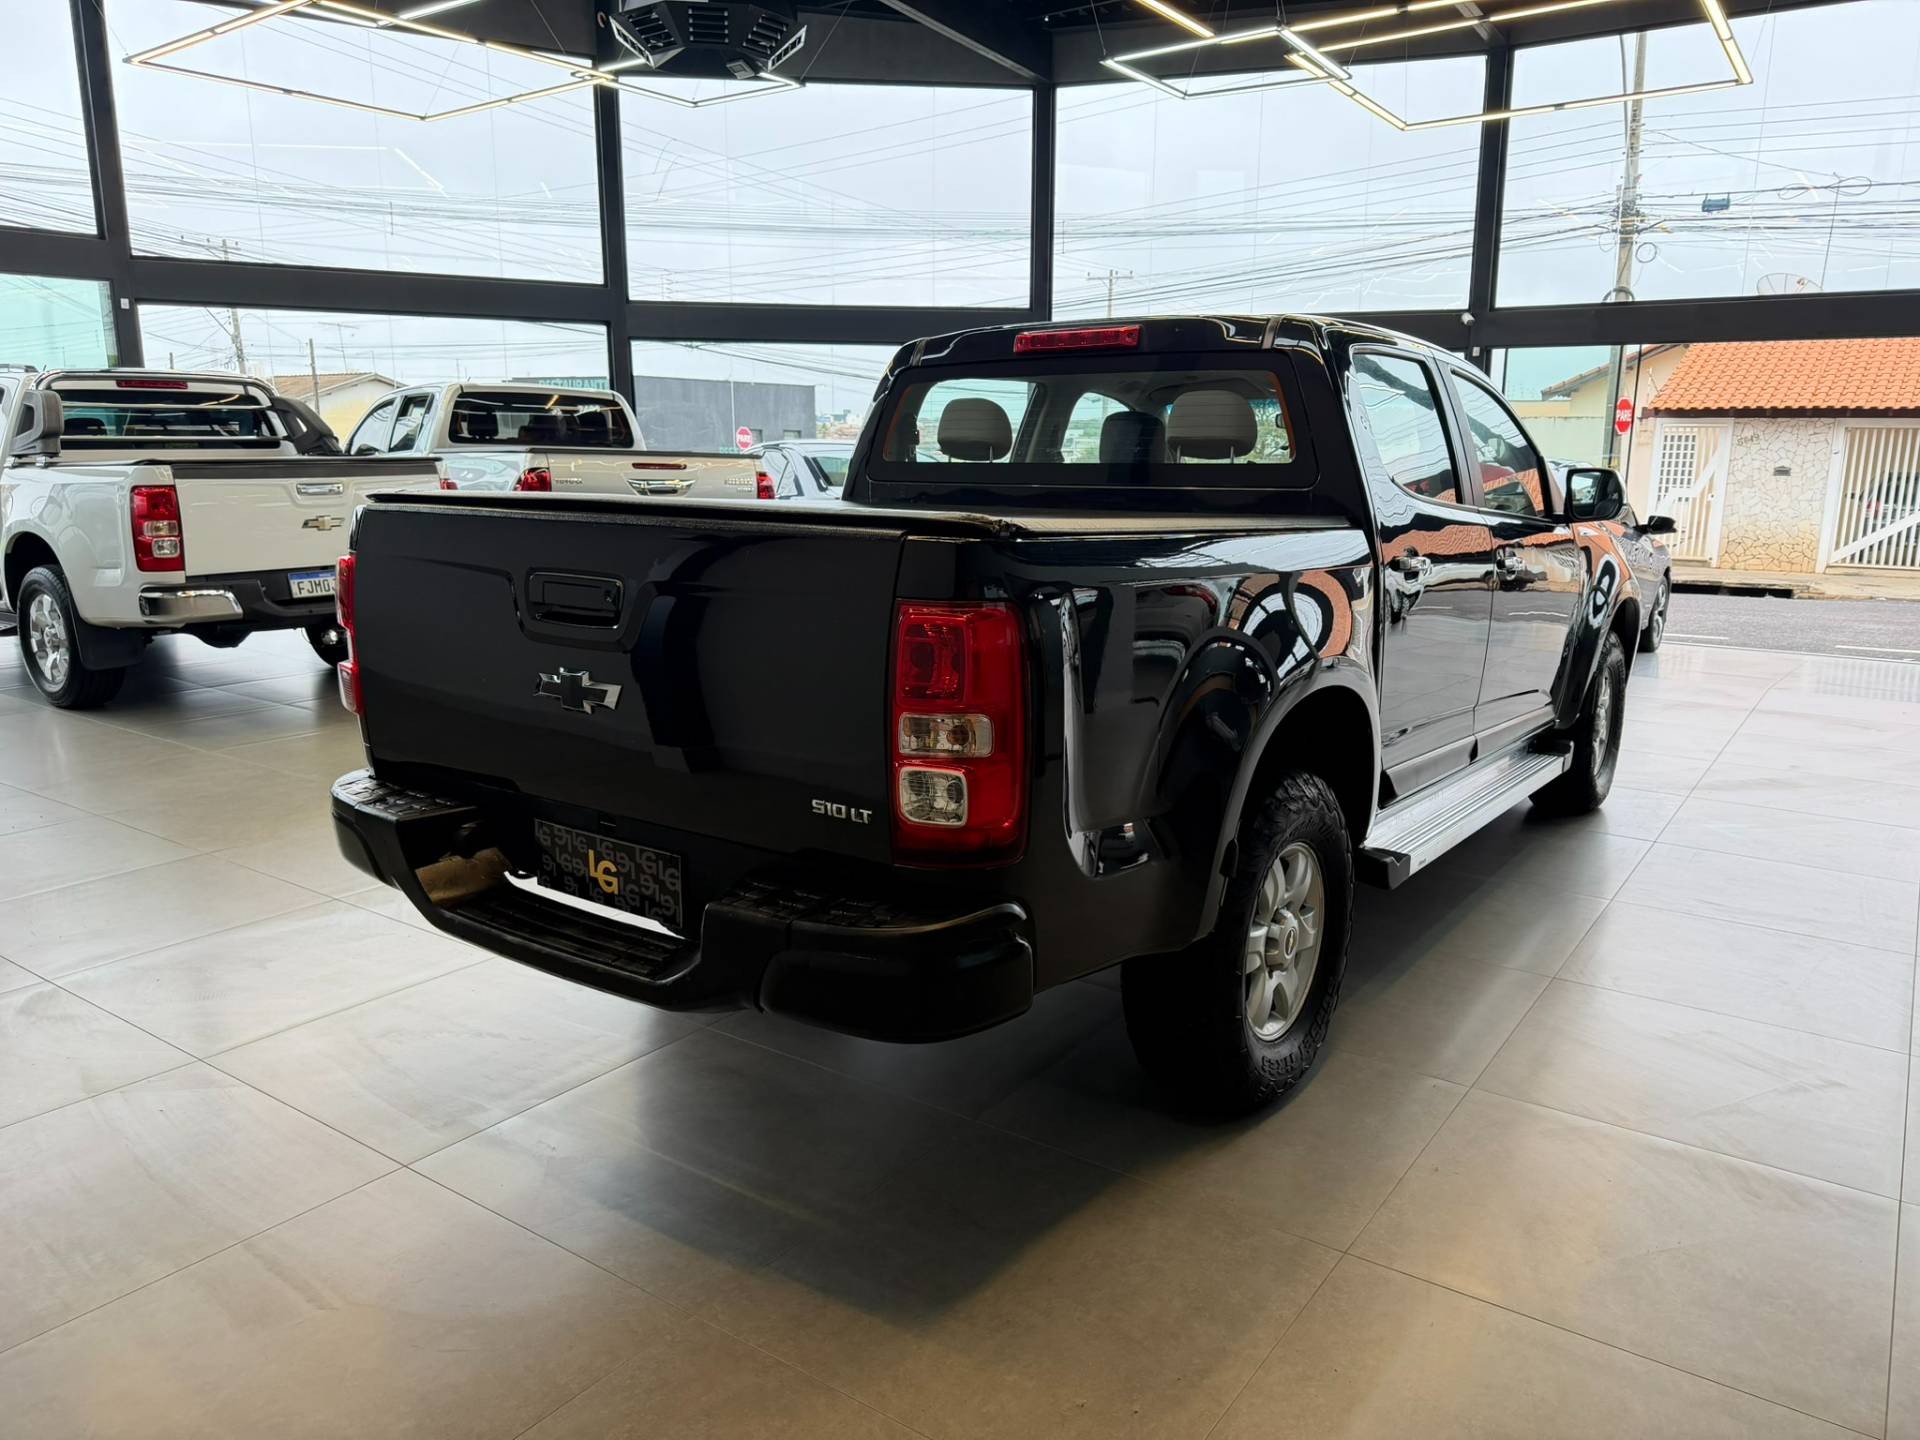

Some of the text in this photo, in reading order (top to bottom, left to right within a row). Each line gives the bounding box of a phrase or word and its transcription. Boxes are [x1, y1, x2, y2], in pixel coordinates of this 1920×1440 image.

[1616, 408, 1632, 421] PARE
[737, 434, 752, 443] PARE
[811, 799, 873, 824] S10 LT
[589, 849, 618, 895] LG
